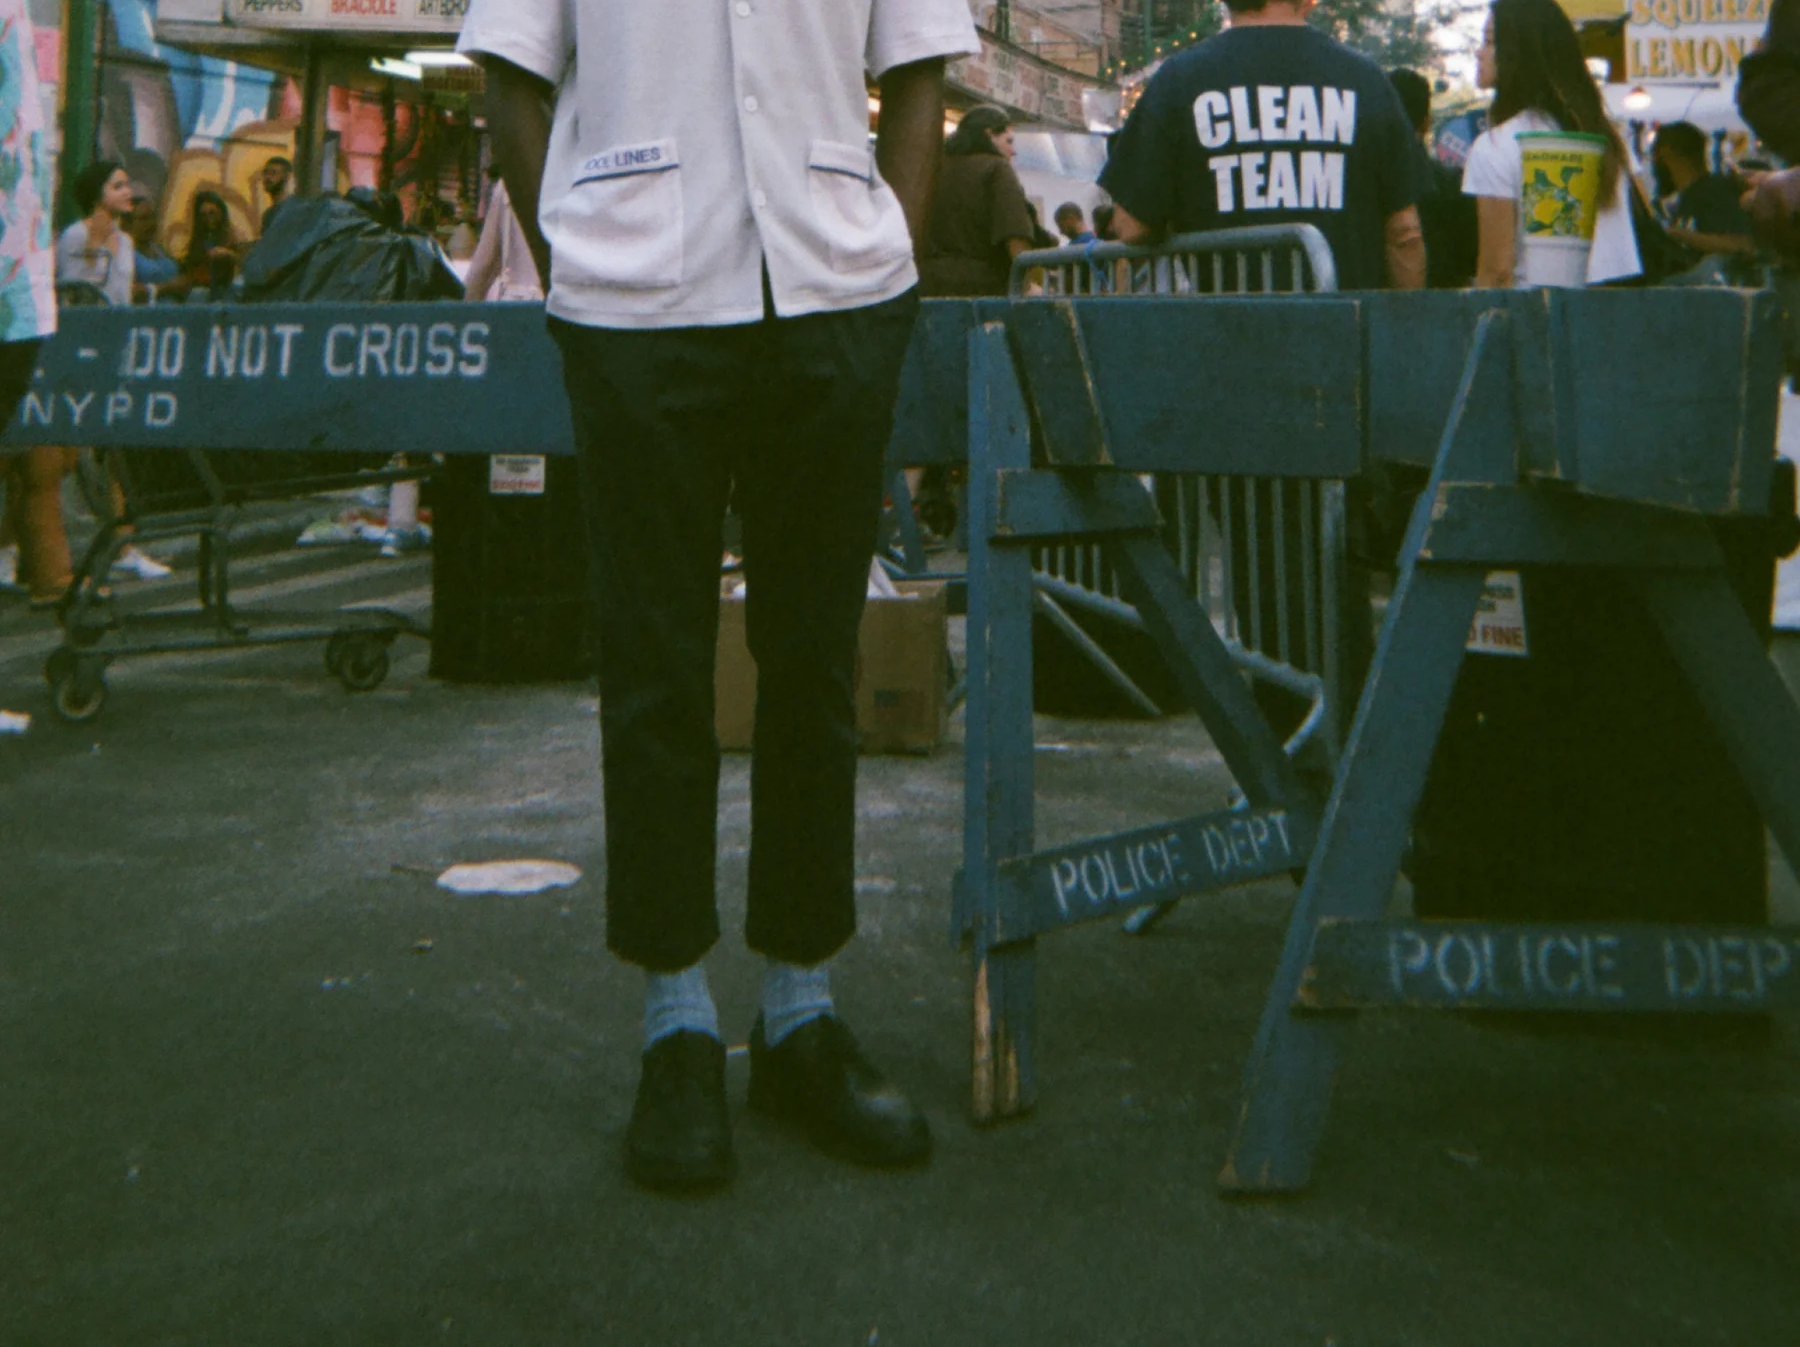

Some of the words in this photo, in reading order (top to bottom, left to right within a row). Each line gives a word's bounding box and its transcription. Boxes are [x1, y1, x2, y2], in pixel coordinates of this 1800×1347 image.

[1629, 36, 1768, 78] LEMON
[1193, 85, 1356, 148] CLEAN
[615, 146, 661, 166] LINES
[1209, 151, 1344, 212] TEAM
[122, 326, 185, 377] DO
[205, 324, 303, 377] NOT
[323, 322, 489, 377] CROSS
[20, 391, 177, 427] NYPD
[1481, 624, 1523, 647] FINE
[1050, 832, 1193, 918] POLICE
[1200, 810, 1292, 873] DEPT
[1390, 931, 1625, 999] POLICE
[1662, 935, 1800, 1000] DEP
